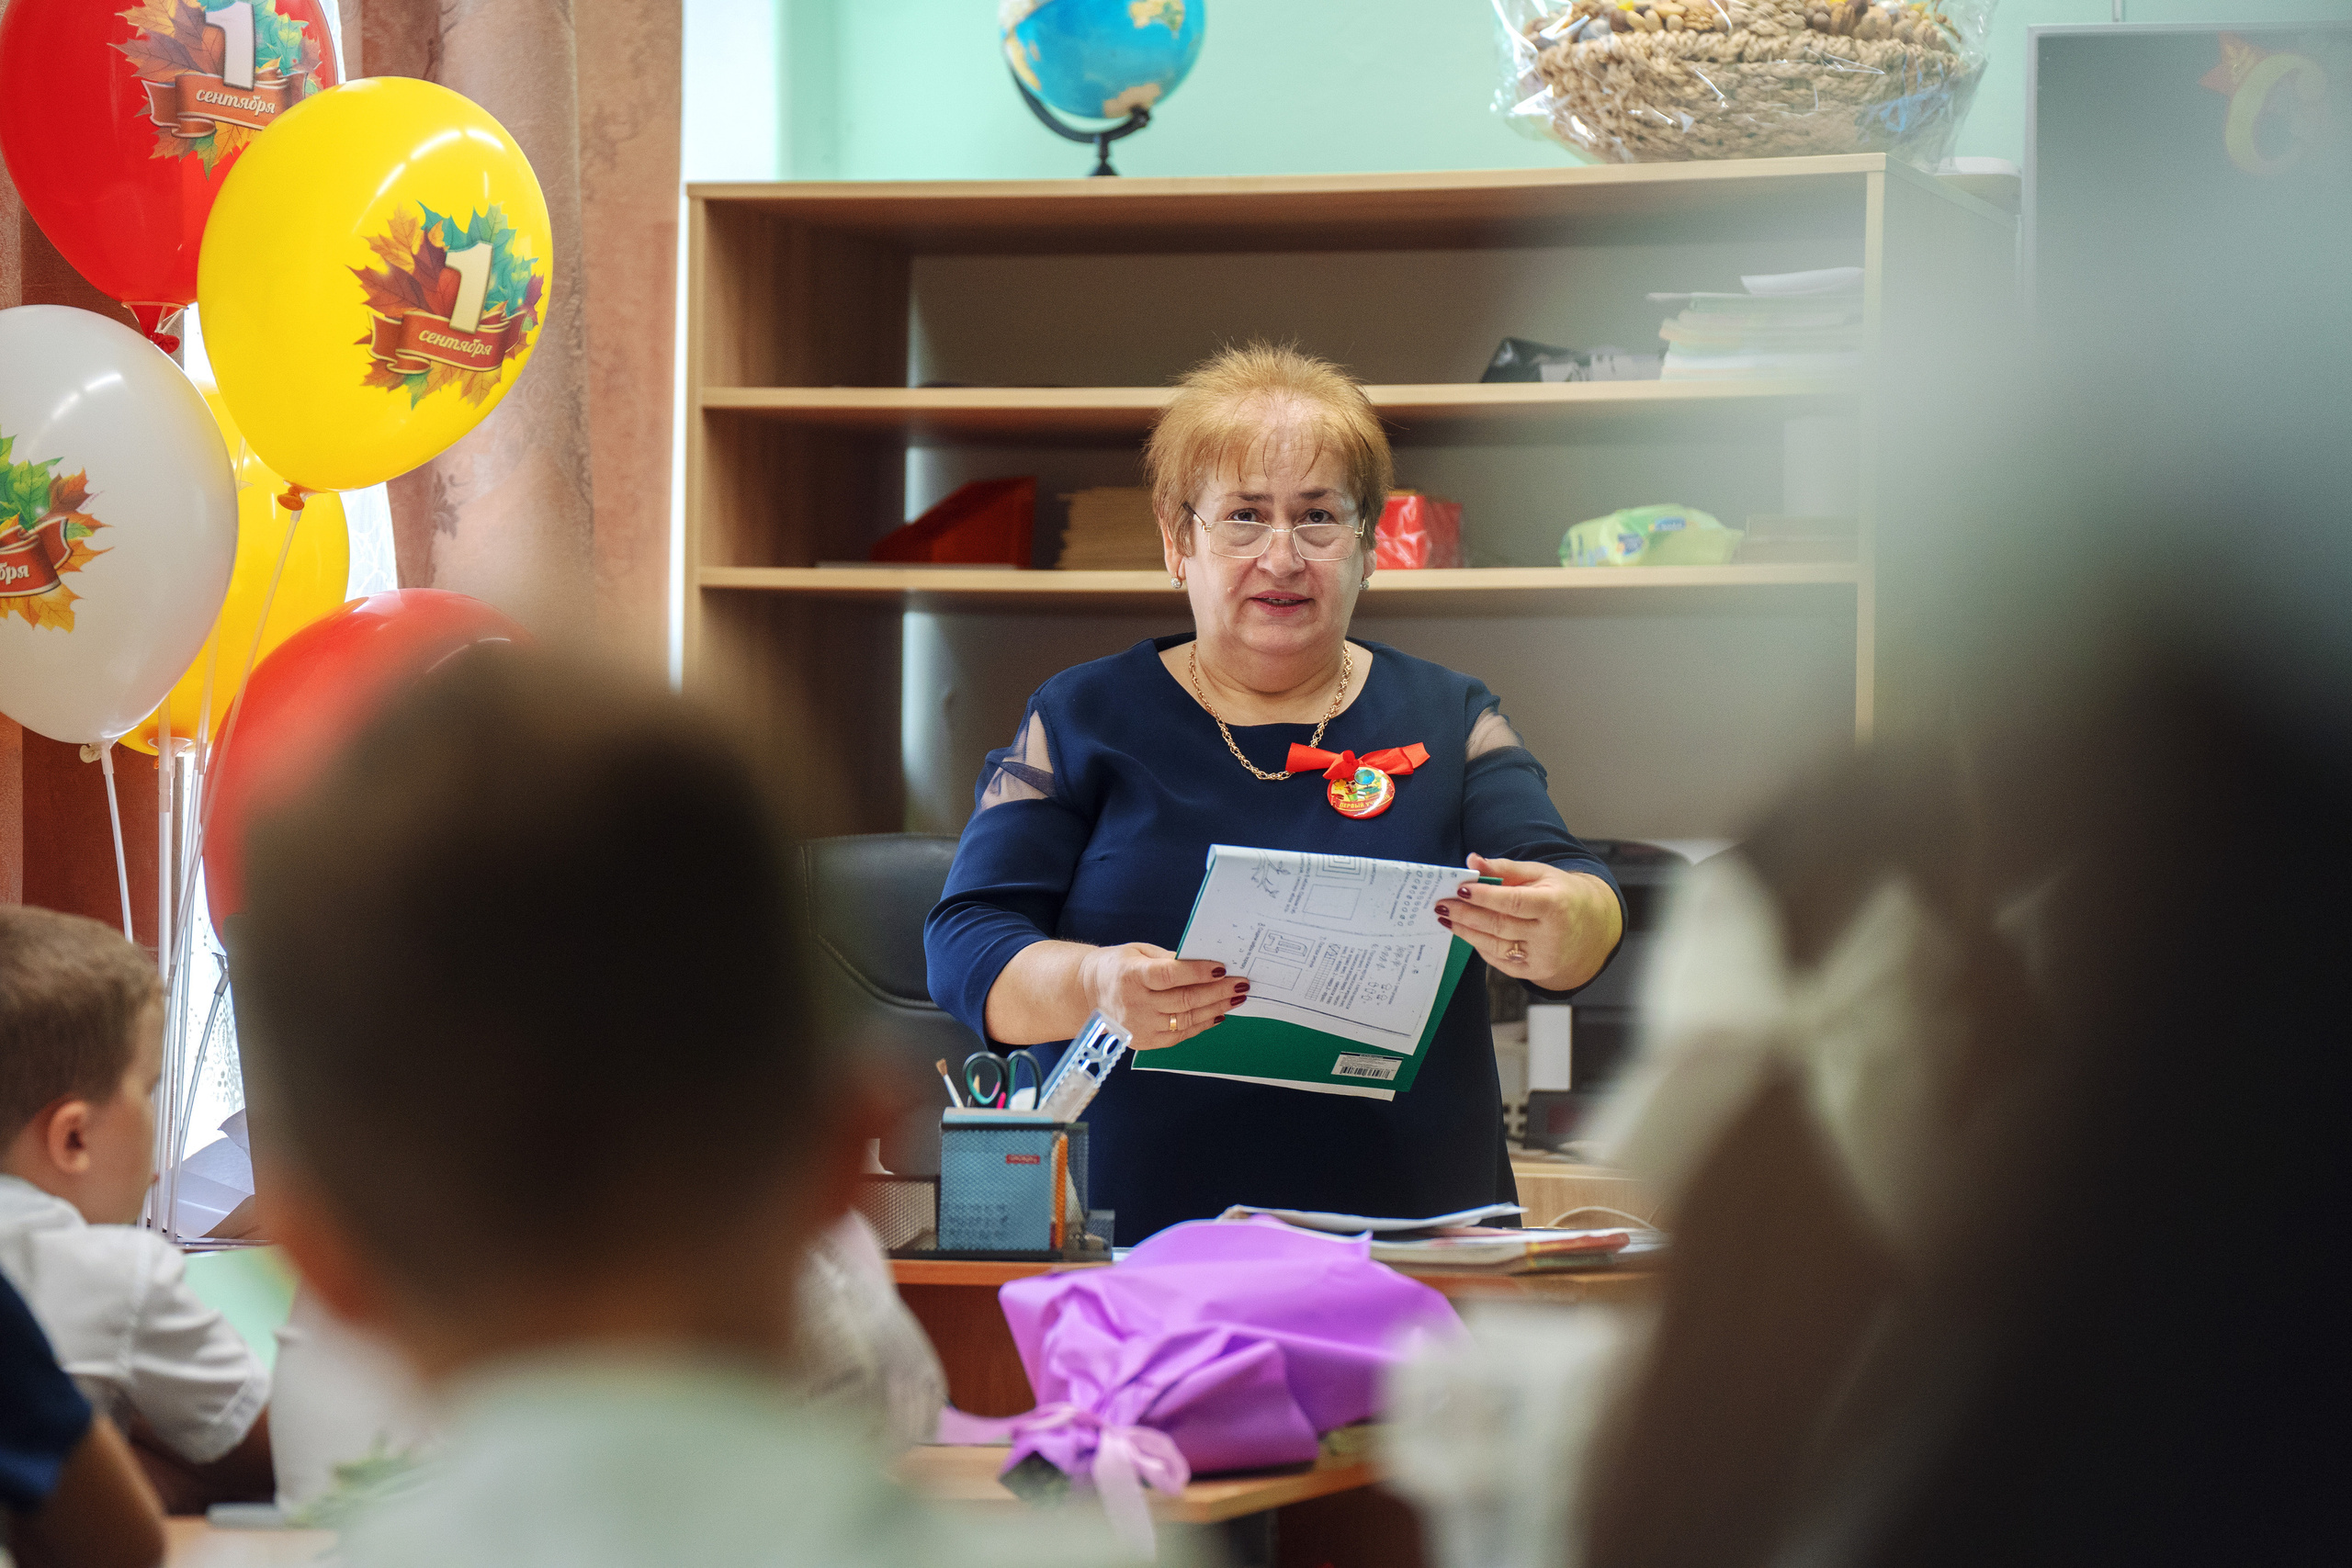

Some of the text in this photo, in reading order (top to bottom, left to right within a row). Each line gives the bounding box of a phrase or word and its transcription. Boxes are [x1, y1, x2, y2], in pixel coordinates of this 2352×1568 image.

[204, 0, 254, 91] 1
[196, 89, 277, 117] сентября
[445, 240, 494, 335] 1
[418, 330, 493, 358] сентября
